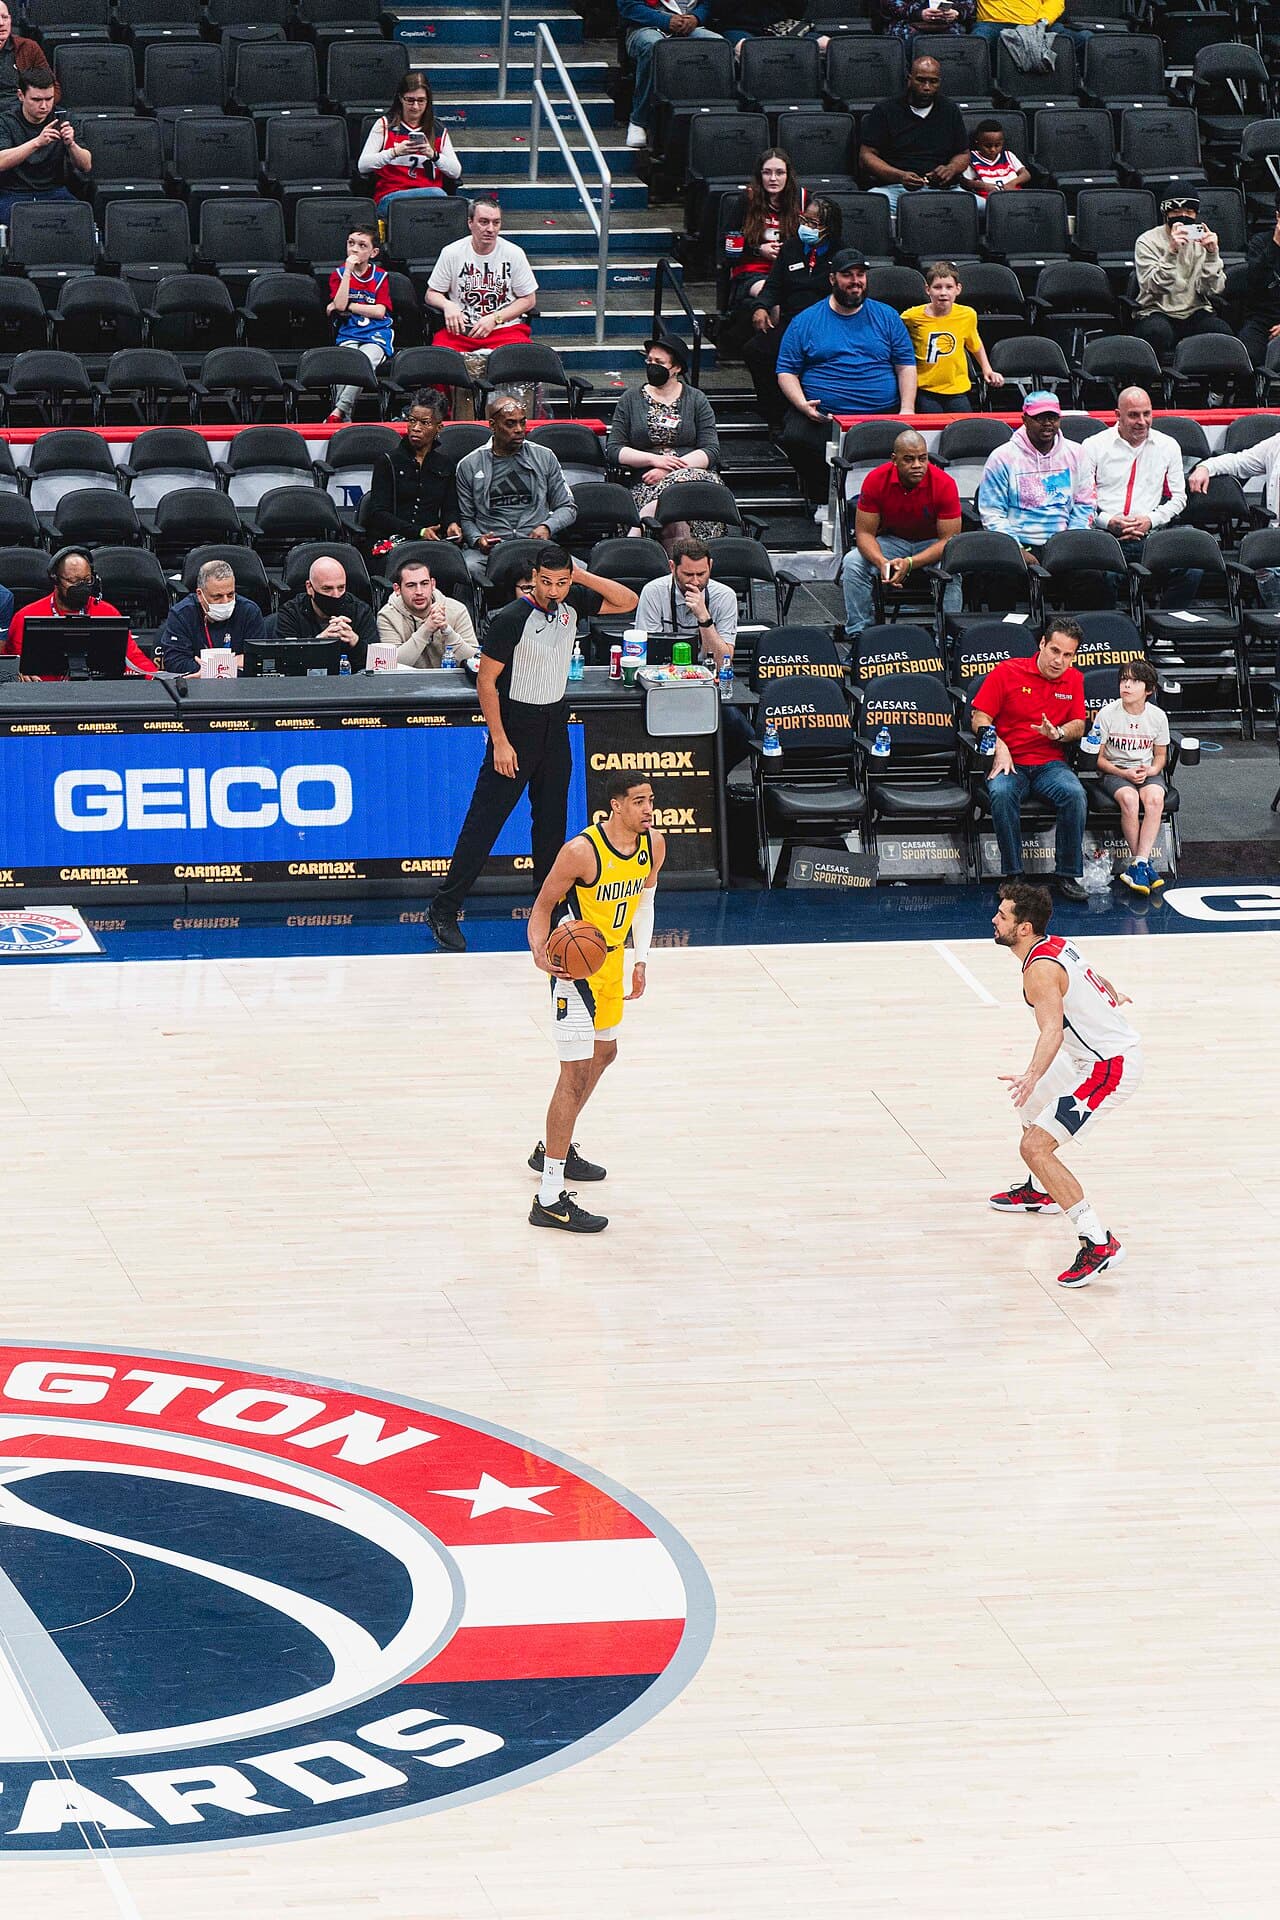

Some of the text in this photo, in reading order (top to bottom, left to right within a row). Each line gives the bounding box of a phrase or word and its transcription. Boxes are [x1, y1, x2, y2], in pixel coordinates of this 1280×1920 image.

[758, 654, 809, 664] CAESARS
[859, 651, 908, 665] CAESARS
[960, 650, 1010, 663] CAESARS
[758, 664, 845, 679] SPORTSBOOK
[859, 657, 945, 680] SPORTSBOOK
[765, 704, 816, 716] CAESARS
[867, 701, 917, 711] CAESARS
[765, 714, 852, 731] SPORTSBOOK
[866, 711, 954, 728] SPORTSBOOK
[53, 763, 354, 832] GEICO
[901, 841, 937, 849] CAESARS
[902, 848, 961, 860] SPORTSBOOK
[814, 863, 850, 875] CAESARS
[813, 871, 871, 888] SPORTSBOOK
[612, 901, 627, 929] 0
